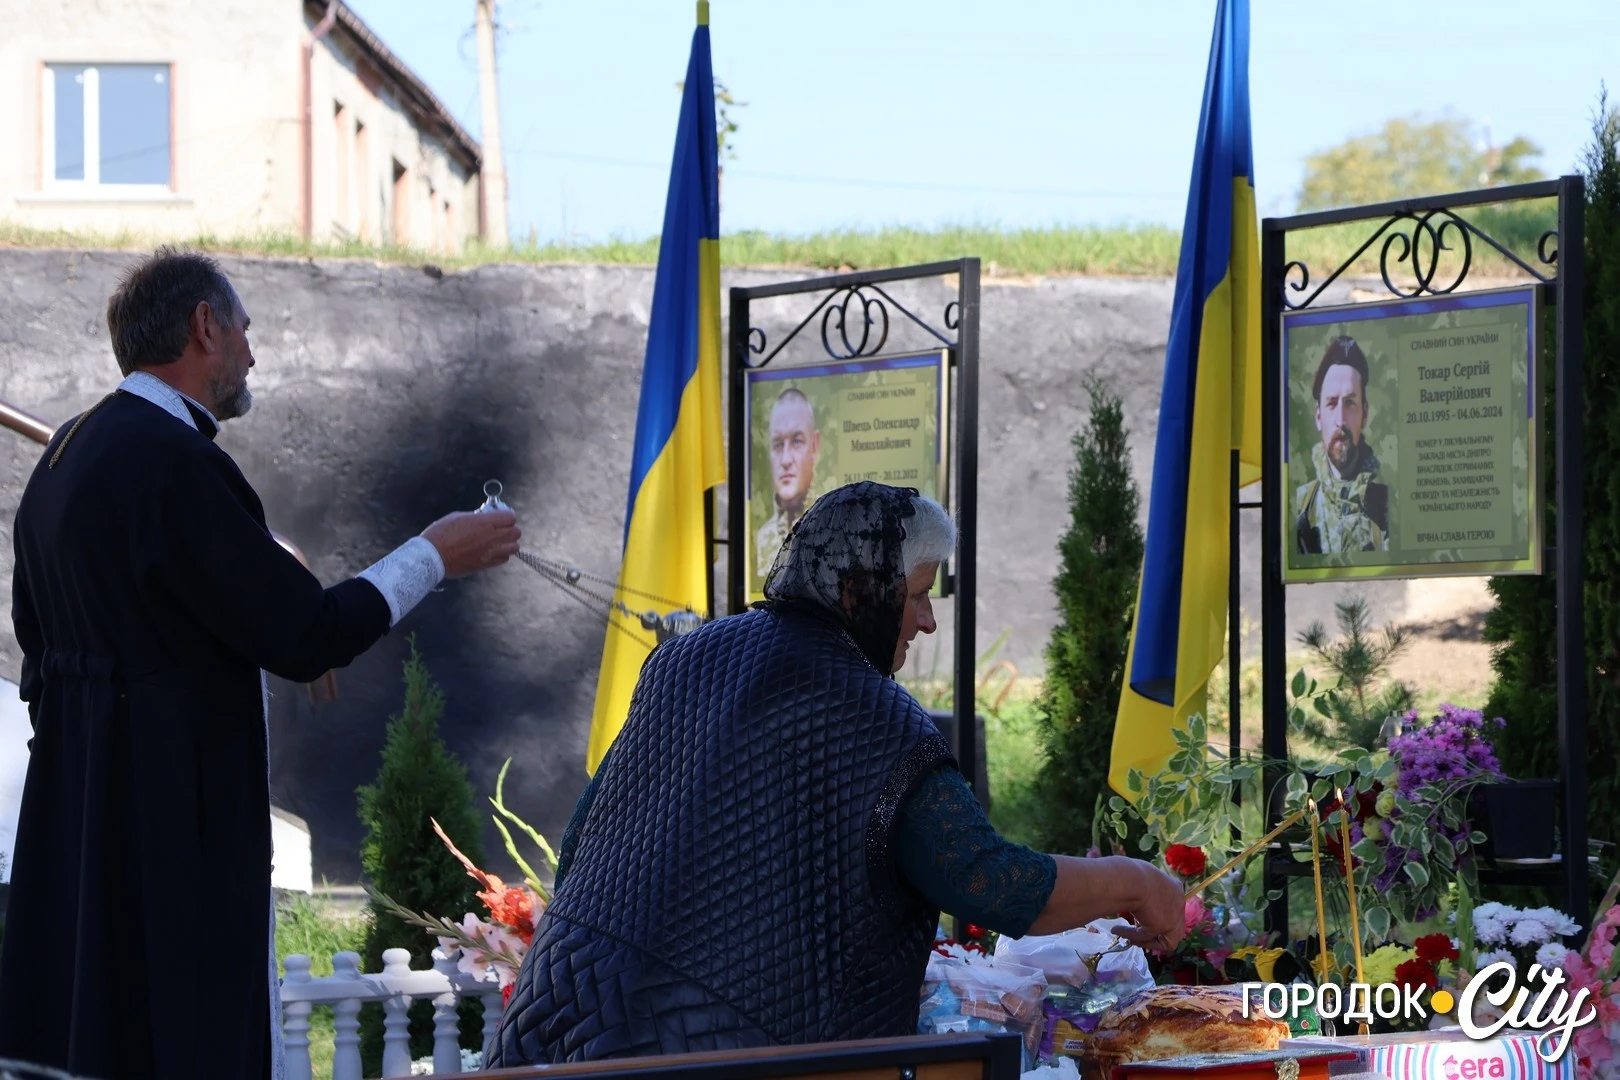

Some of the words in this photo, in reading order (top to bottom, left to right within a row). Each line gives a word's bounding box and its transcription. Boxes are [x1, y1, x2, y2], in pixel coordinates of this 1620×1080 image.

[1411, 336, 1447, 351] СЛАВНИЙ
[1448, 336, 1465, 348] СИН
[1466, 332, 1500, 346] УКРАЇНИ
[1417, 366, 1451, 382] Токар
[1453, 360, 1491, 380] Сергій
[1419, 386, 1492, 405] Валерійович
[1406, 409, 1451, 424] 20.10.1995
[1457, 406, 1504, 420] 04.06.2024
[843, 420, 872, 433] Швець
[872, 417, 920, 431] Олександр
[851, 437, 912, 452] Миколайович
[1416, 533, 1439, 543] ВІЧНА
[1440, 531, 1466, 541] СЛАВА
